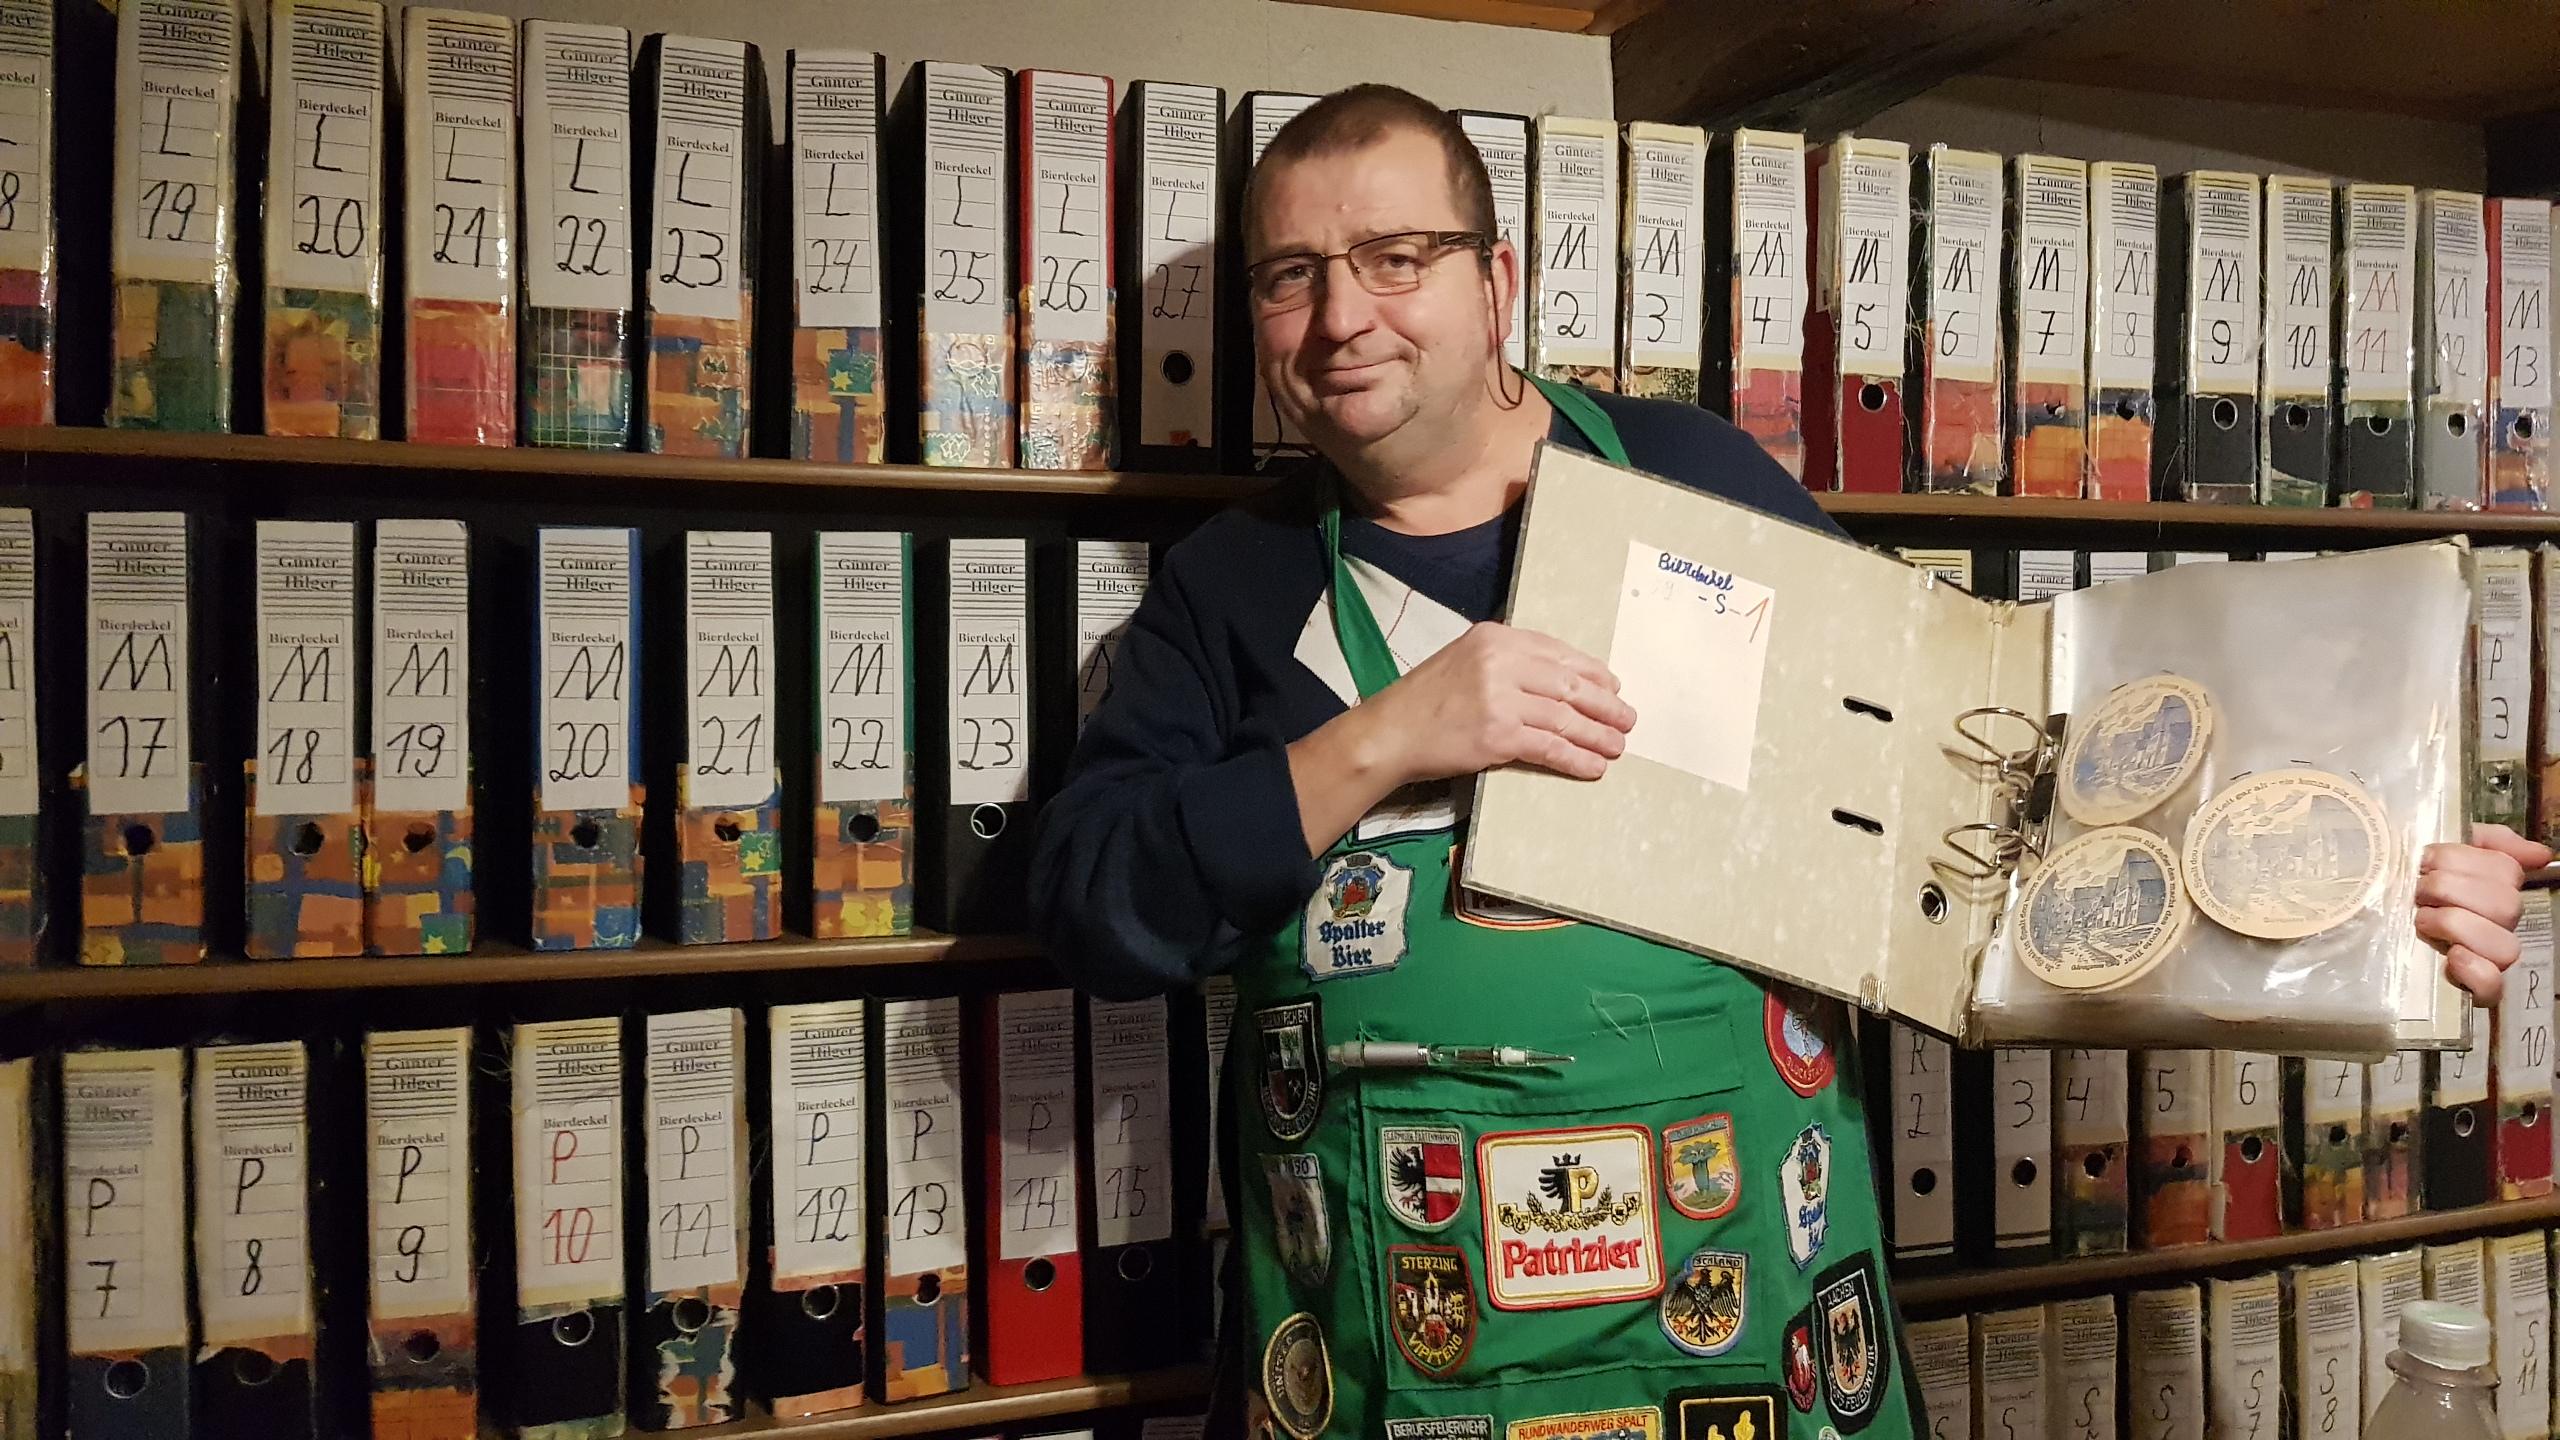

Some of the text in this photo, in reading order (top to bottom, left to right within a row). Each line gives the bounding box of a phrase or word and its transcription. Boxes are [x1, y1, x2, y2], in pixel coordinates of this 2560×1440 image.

[144, 81, 215, 99] Bierdeckel
[811, 75, 863, 91] Günter
[816, 93, 863, 111] Hilger
[161, 99, 191, 156] L
[298, 99, 367, 116] Bierdeckel
[435, 112, 501, 129] Bierdeckel
[1159, 105, 1207, 123] Günter
[313, 113, 343, 172] L
[553, 123, 618, 139] Bierdeckel
[667, 136, 730, 153] Bierdeckel
[804, 148, 865, 160] Bierdeckel
[1164, 125, 1205, 142] Hilger
[1555, 144, 1596, 160] Günter
[446, 127, 482, 183] L
[570, 137, 599, 194] L
[934, 160, 992, 176] Bierdeckel
[1040, 169, 1096, 184] Bierdeckel
[1559, 162, 1595, 178] Hilger
[1646, 150, 1686, 165] Günter
[1650, 167, 1685, 184] Hilger
[678, 152, 712, 208] L
[825, 163, 850, 216] L
[953, 176, 973, 228] L
[1151, 175, 1206, 191] Bierdeckel
[142, 180, 196, 241] 19
[298, 196, 364, 258] 20
[1058, 184, 1085, 238] L
[1165, 191, 1187, 243] L
[1547, 210, 1596, 223] Bierdeckel
[1638, 214, 1683, 229] Bierdeckel
[1744, 219, 1791, 231] Bierdeckel
[434, 204, 485, 268] 21
[557, 215, 611, 276] 22
[660, 227, 724, 288] 23
[1551, 223, 1586, 270] M
[1641, 228, 1680, 278] M
[1748, 230, 1785, 279] M
[810, 240, 857, 294] 24
[934, 249, 990, 305] 25
[1039, 255, 1090, 313] 26
[1849, 238, 1879, 284] M
[1942, 247, 1973, 294] M
[2029, 246, 2060, 292] M
[2115, 250, 2150, 296] M
[2206, 258, 2240, 303] M
[1152, 264, 1203, 320] 27
[2289, 265, 2319, 308] M
[2359, 270, 2399, 312] M
[2438, 277, 2469, 319] M
[2508, 289, 2540, 330] M
[1554, 291, 1586, 339] 2
[1646, 293, 1669, 343] 3
[1753, 296, 1772, 345] 4
[1854, 303, 1875, 350] 5
[1941, 311, 1960, 357] 6
[2038, 311, 2056, 355] 7
[2125, 311, 2137, 357] 8
[2211, 319, 2232, 365] 9
[2288, 325, 2316, 370] 10
[2355, 327, 2387, 374] 11
[2506, 344, 2538, 388] 13
[965, 562, 1015, 576] Günter
[971, 580, 1014, 595] Hilger
[100, 619, 171, 631] Bierdeckel
[269, 633, 339, 645] Bierdeckel
[551, 633, 616, 643] Bierdeckel
[698, 631, 759, 643] Bierdeckel
[830, 630, 890, 641] Bierdeckel
[958, 632, 1015, 644] Bierdeckel
[98, 631, 171, 691] M
[269, 645, 329, 702] M
[387, 643, 448, 696] M
[554, 641, 623, 700] M
[697, 644, 758, 697] M
[830, 643, 883, 696] M
[963, 643, 1014, 697] M
[2490, 638, 2503, 680] P
[2491, 697, 2509, 739] 3
[98, 716, 168, 778] 17
[268, 728, 319, 784] 18
[387, 724, 445, 777] 19
[549, 722, 609, 782] 20
[697, 714, 762, 776] 21
[832, 718, 889, 770] 22
[958, 718, 1013, 770] 23
[1320, 919, 1386, 945] Spalter
[1332, 944, 1373, 968] Bier
[2526, 969, 2539, 1009] R
[804, 1025, 857, 1041] Günter
[809, 1045, 853, 1060] Hilger
[2521, 1026, 2547, 1067] 10
[797, 1096, 857, 1112] Bierdeckel
[2012, 1080, 2034, 1128] 3
[2066, 1077, 2091, 1120] 4
[2158, 1068, 2176, 1112] 5
[2240, 1062, 2256, 1105] 6
[543, 1115, 608, 1130] Bierdeckel
[912, 1109, 934, 1162] P
[1027, 1102, 1052, 1154] P
[1118, 1093, 1138, 1144] P
[1908, 1093, 1930, 1138] 2
[552, 1131, 577, 1184] P
[681, 1125, 700, 1180] P
[807, 1112, 830, 1166] P
[235, 1158, 264, 1215] P
[395, 1146, 421, 1204] P
[1105, 1166, 1149, 1220] 15
[86, 1178, 115, 1238] P
[797, 1186, 848, 1243] 12
[893, 1182, 947, 1240] 13
[1014, 1178, 1058, 1231] 14
[395, 1225, 425, 1283] 9
[543, 1208, 594, 1264] 10
[660, 1203, 711, 1260] 11
[242, 1239, 261, 1296] 8
[1401, 1255, 1458, 1273] STERZING
[1501, 1235, 1642, 1280] Patrizier
[87, 1260, 117, 1317] 7
[1408, 1331, 1463, 1366] VIPITENO
[2517, 1359, 2537, 1396] 11
[1393, 1420, 1488, 1438] BERUFSFEUERWEHR
[1519, 1415, 1648, 1440] RUNDWANDERWEG SPALT
[2322, 1396, 2338, 1432] 8
